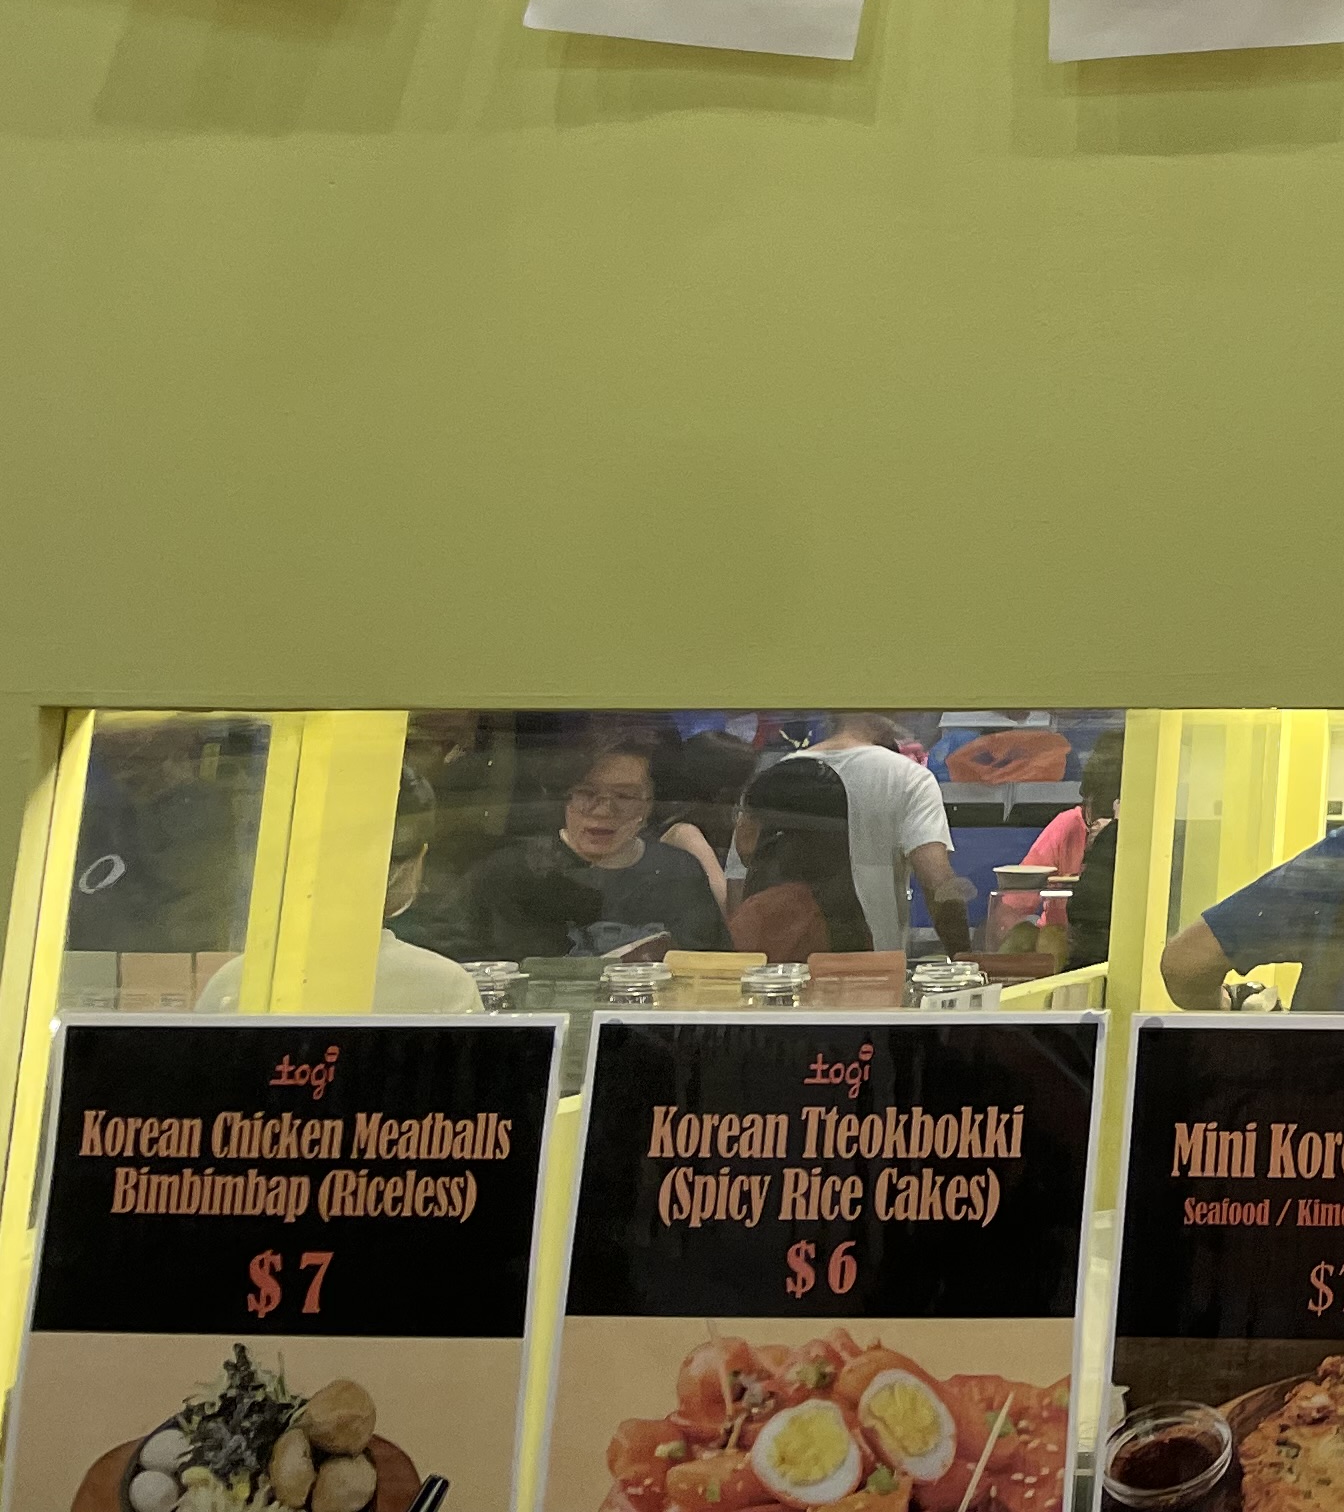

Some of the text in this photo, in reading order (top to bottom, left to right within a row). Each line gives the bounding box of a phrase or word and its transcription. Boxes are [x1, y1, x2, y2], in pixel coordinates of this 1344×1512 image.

[79, 1110, 513, 1161] Korean Chicken Meatballs
[647, 1104, 1025, 1159] Korean Tteokbokki
[1171, 1121, 1258, 1179] Mini
[110, 1167, 478, 1224] Bimbimbap (Riceless)
[658, 1167, 1001, 1228] (Spicy Rice Cakes)
[1183, 1197, 1270, 1227] Seafood
[1276, 1198, 1293, 1227] /
